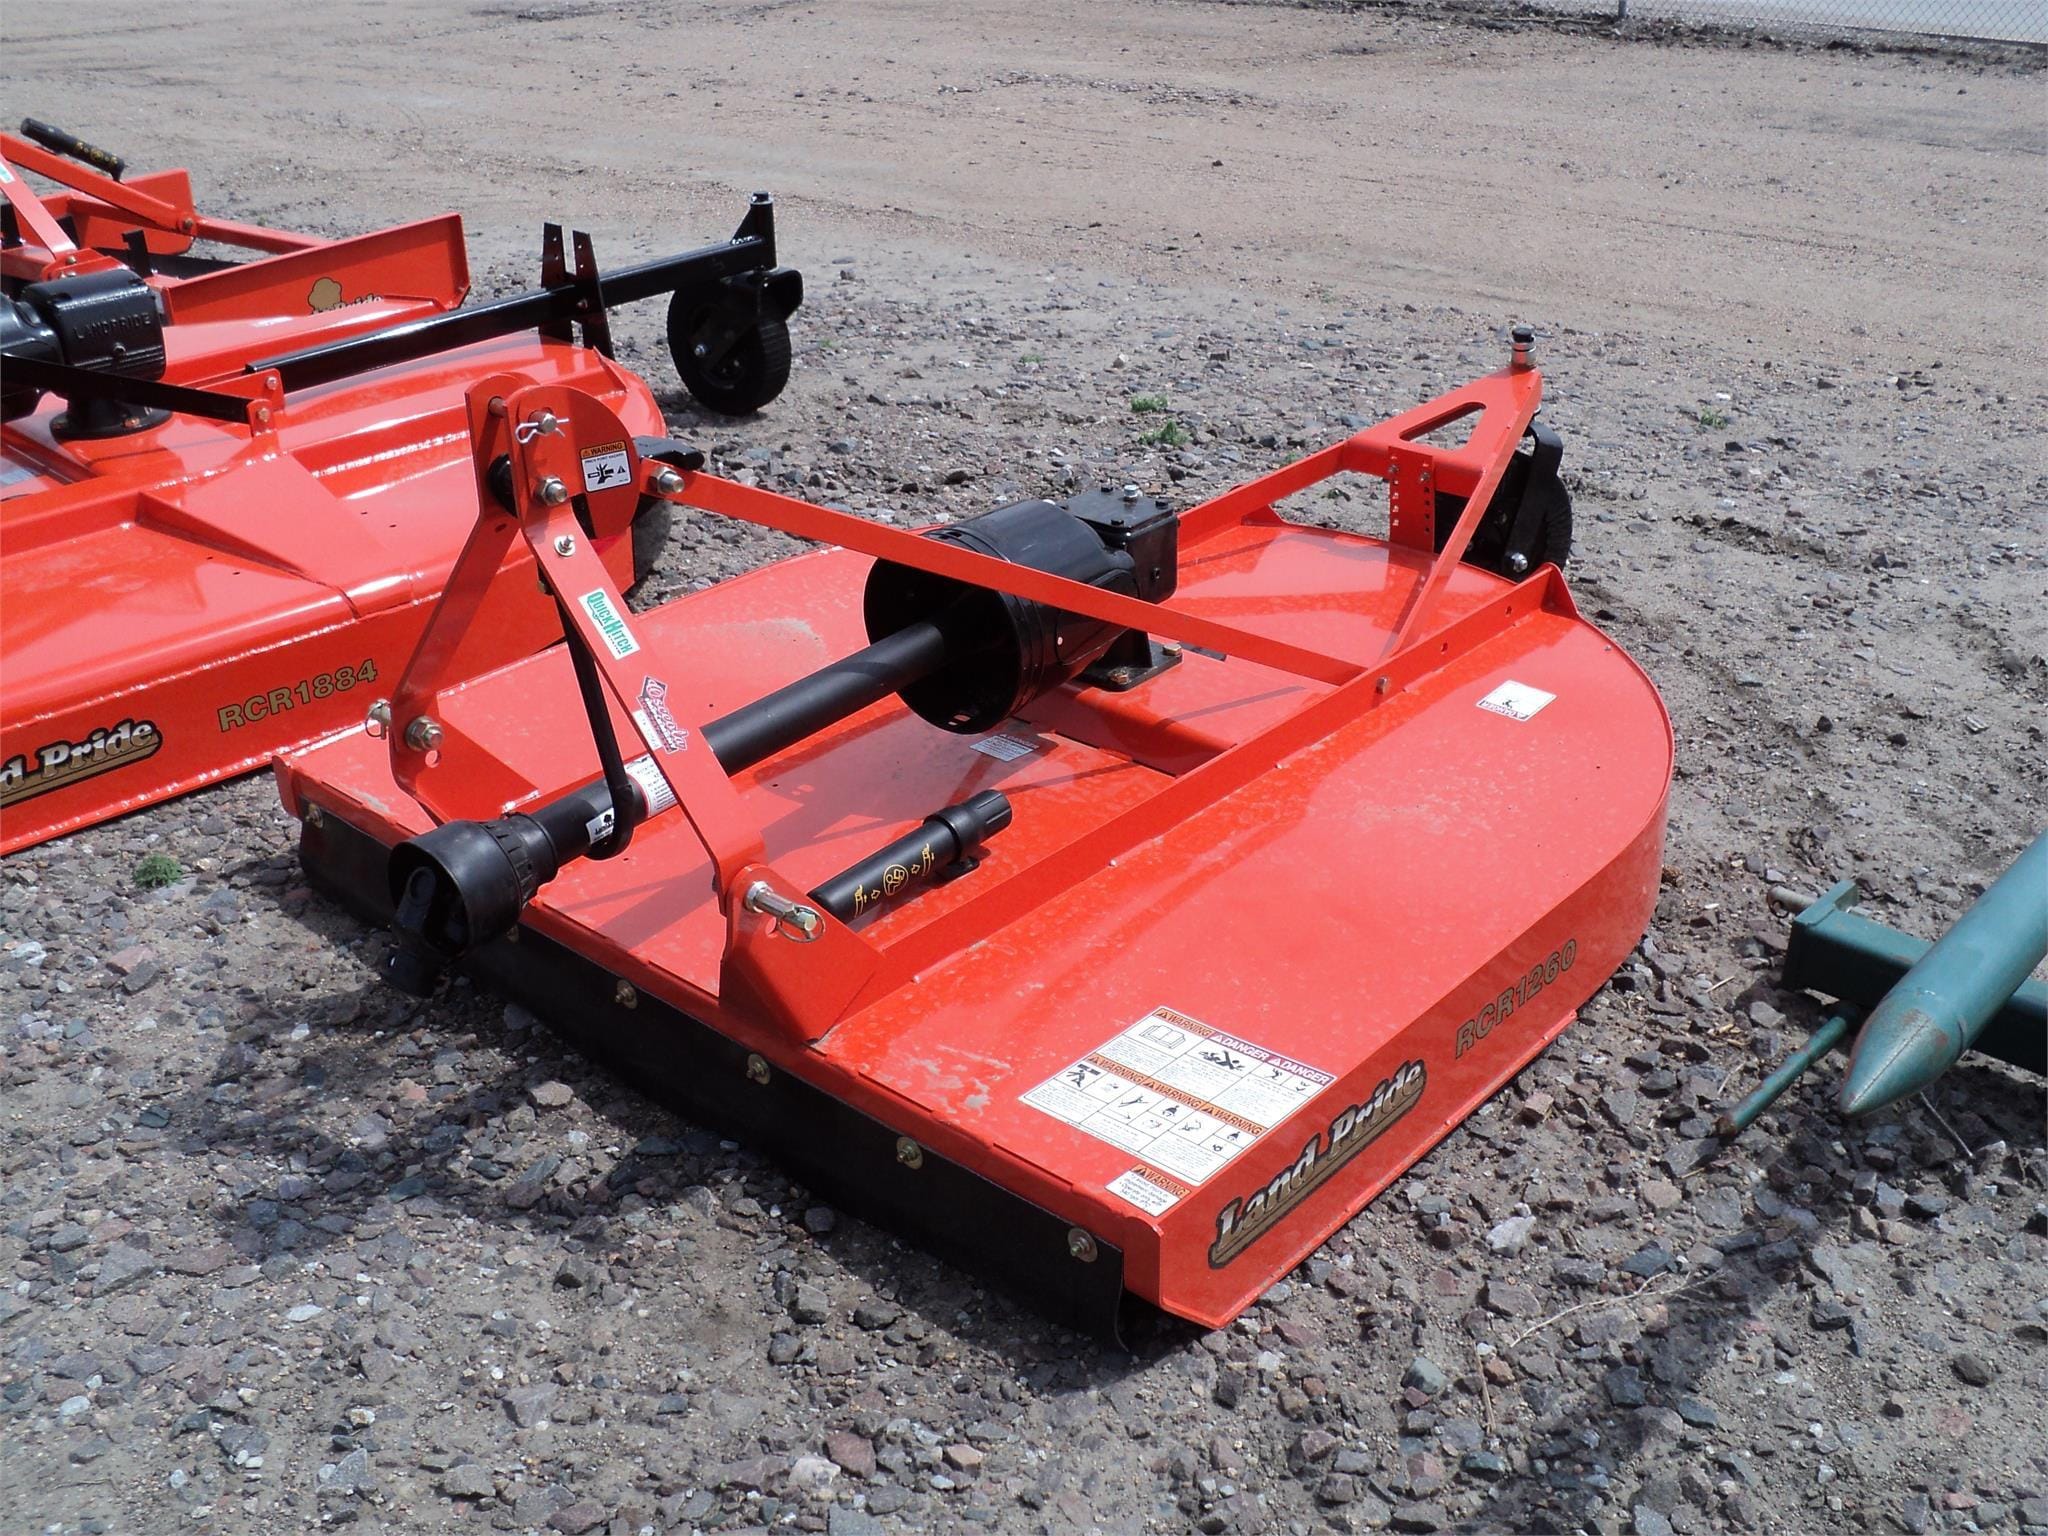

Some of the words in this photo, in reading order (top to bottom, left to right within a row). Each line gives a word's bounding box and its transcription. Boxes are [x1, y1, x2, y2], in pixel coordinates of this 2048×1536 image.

[590, 442, 623, 456] WARNING
[217, 659, 378, 732] RCR1884
[40, 720, 154, 779] Pride
[1456, 938, 1577, 1060] RCR1260
[1169, 1013, 1212, 1038] WARNING
[1222, 1036, 1268, 1062] DANGER
[1098, 1059, 1144, 1085] WARNING
[1281, 1058, 1335, 1085] DANGER
[1156, 1083, 1202, 1109] WARNING
[1213, 1108, 1267, 1137] WARNING
[1215, 1139, 1320, 1254] Land
[1327, 1060, 1424, 1162] Pride
[1146, 1172, 1186, 1197] WARNING
